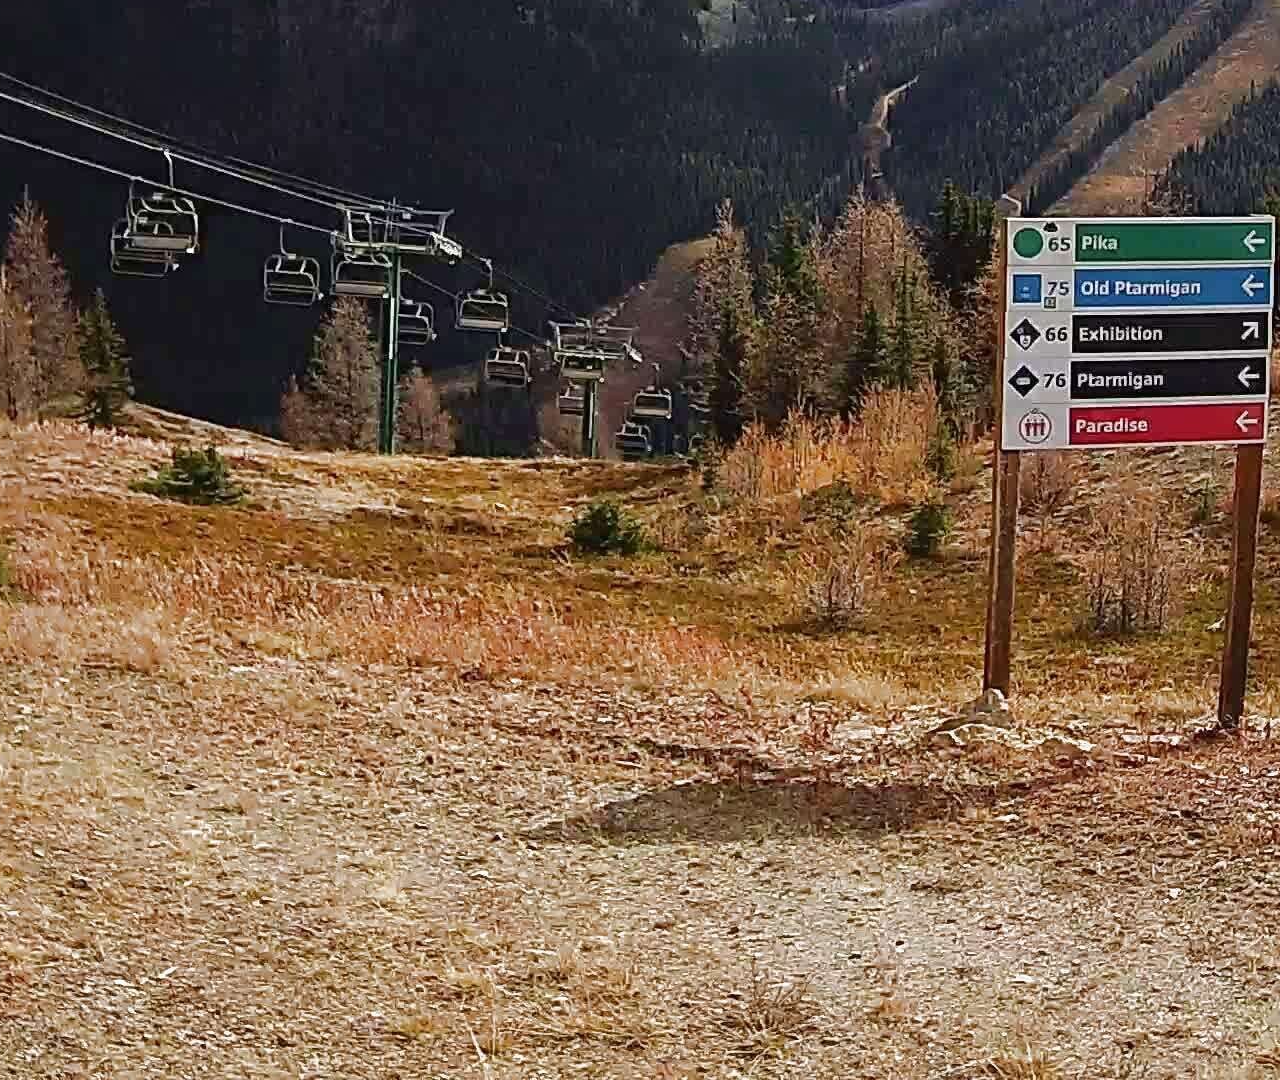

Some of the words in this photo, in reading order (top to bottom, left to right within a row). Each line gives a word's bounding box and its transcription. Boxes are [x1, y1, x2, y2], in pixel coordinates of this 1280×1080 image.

[1048, 236, 1071, 252] 65
[1080, 235, 1118, 251] Pika
[1047, 281, 1070, 297] 75
[1080, 279, 1109, 296] Old
[1114, 278, 1201, 299] Ptarmigan
[1045, 326, 1068, 342] 66
[1079, 325, 1163, 342] Exhibition
[1043, 372, 1066, 389] 76
[1076, 372, 1164, 390] Ptarmigan
[1075, 417, 1148, 433] Paradise
